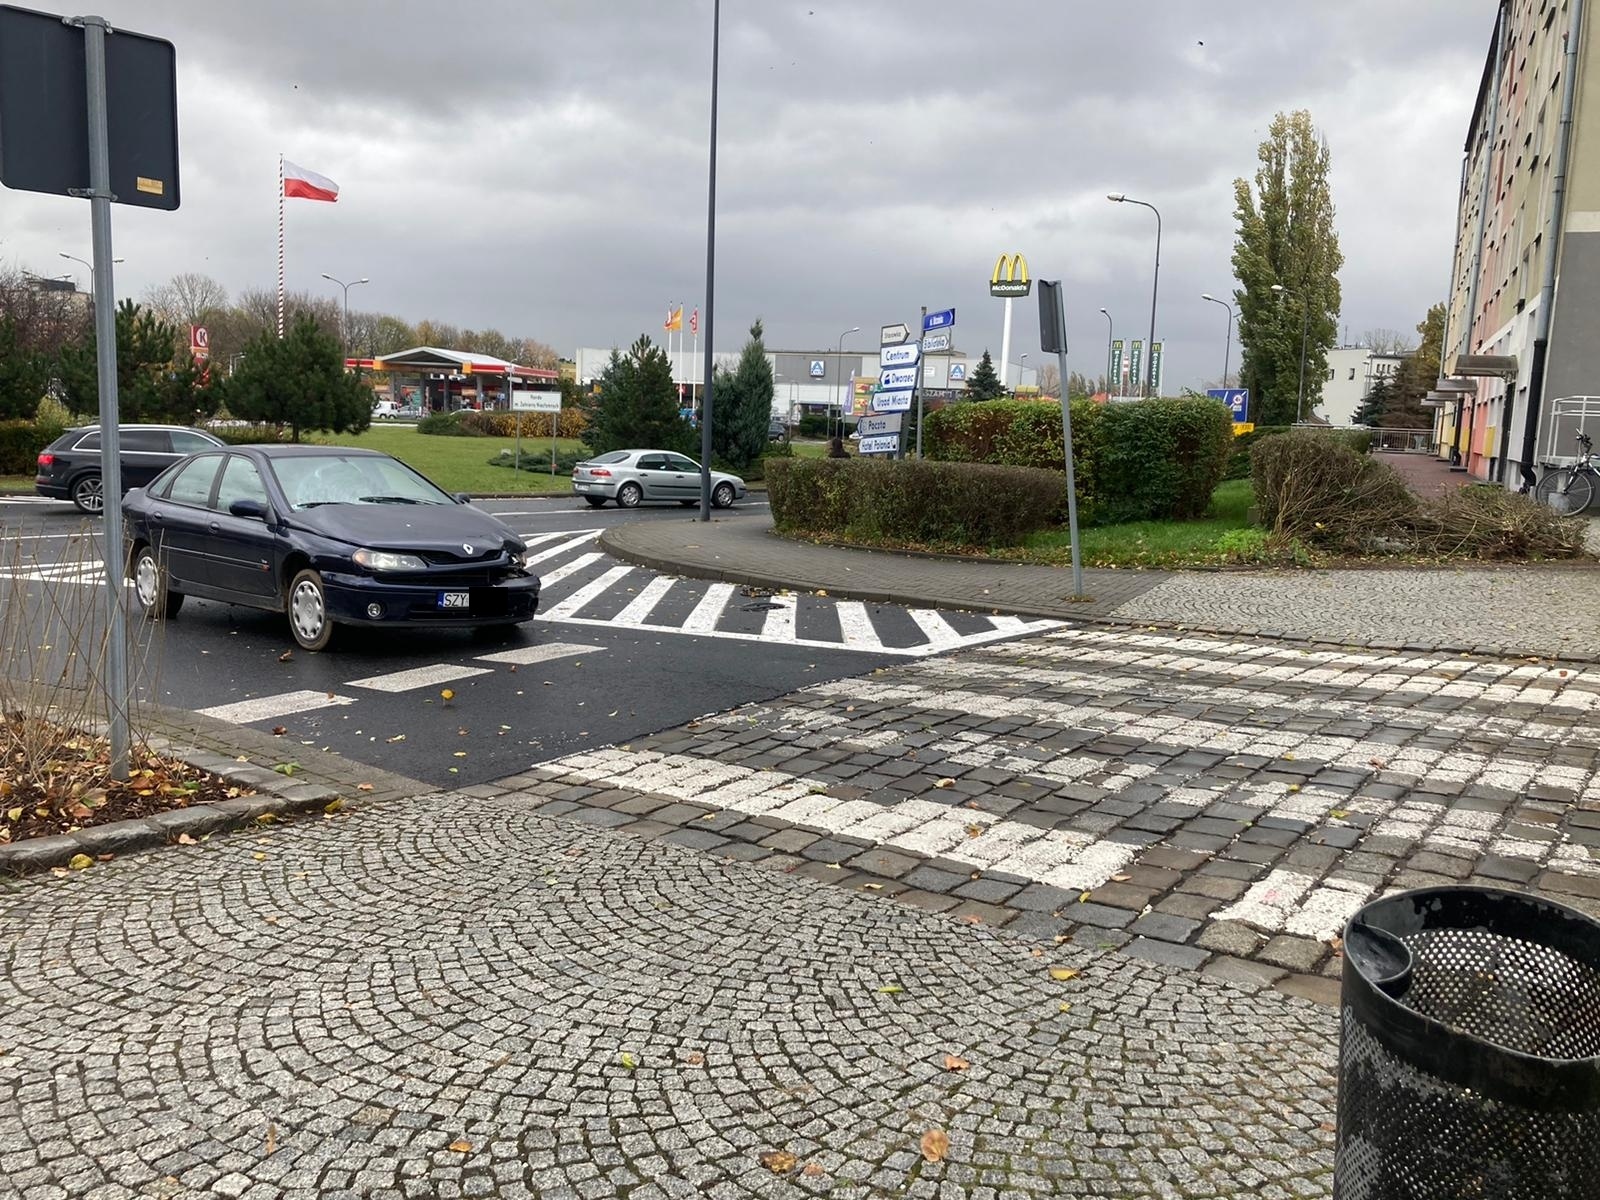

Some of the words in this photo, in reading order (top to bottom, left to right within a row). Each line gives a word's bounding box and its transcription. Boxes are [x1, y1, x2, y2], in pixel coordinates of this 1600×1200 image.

[885, 350, 910, 361] Centrum
[891, 373, 914, 384] Dworzec
[891, 394, 909, 406] Miasta
[868, 419, 886, 431] Poczta
[444, 593, 467, 607] SZY
